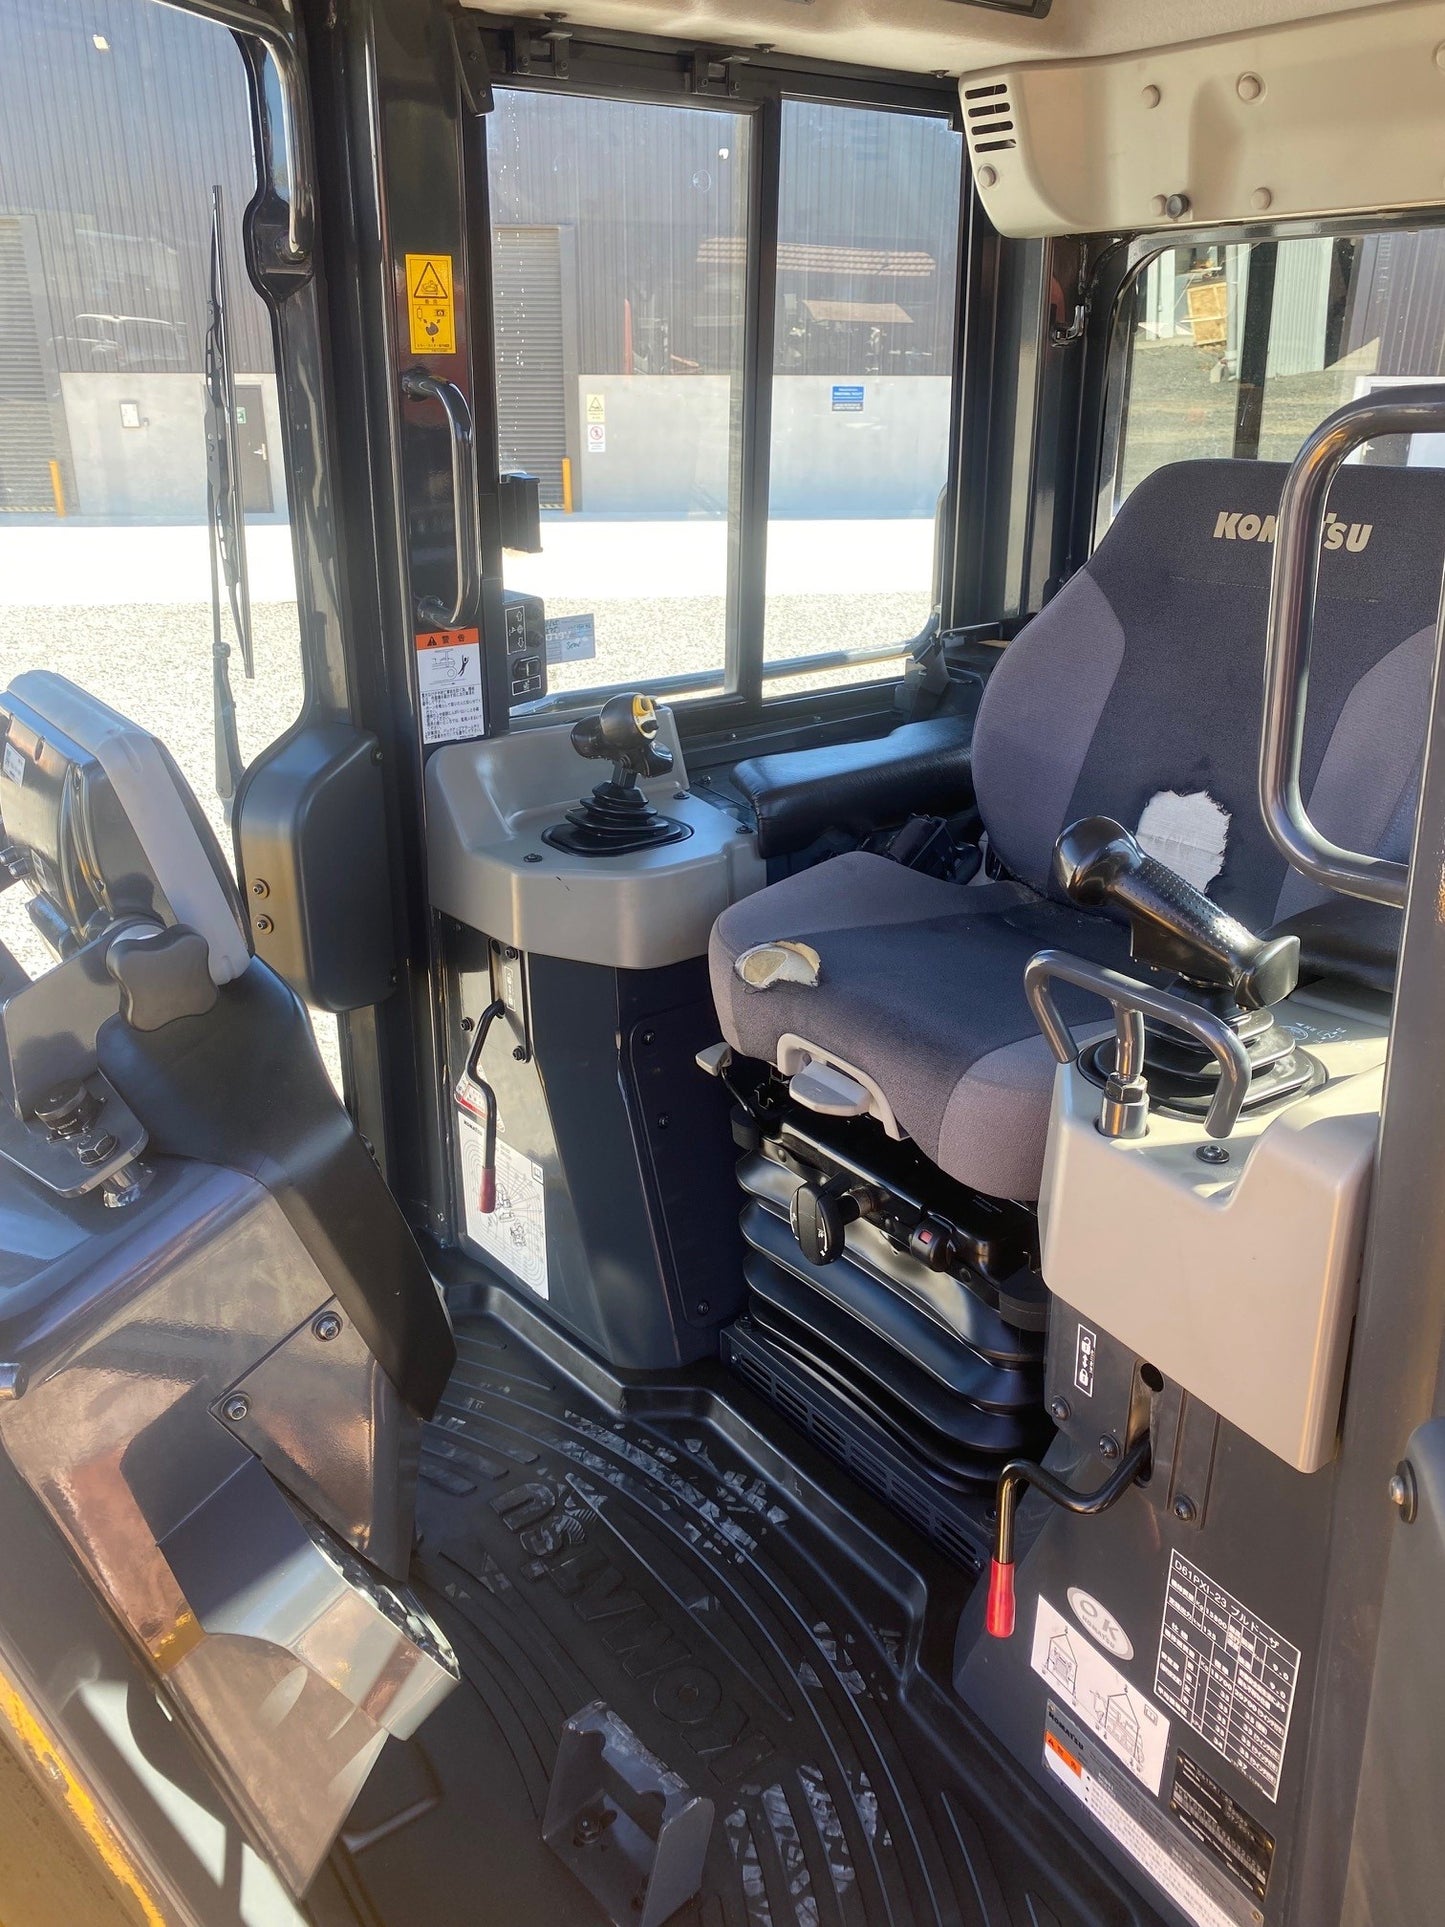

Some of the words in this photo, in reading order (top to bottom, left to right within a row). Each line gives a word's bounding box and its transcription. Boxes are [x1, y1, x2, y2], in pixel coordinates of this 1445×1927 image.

[1213, 511, 1373, 553] KOMSU
[464, 1121, 482, 1136] KOMATSU
[1080, 1600, 1119, 1641] OK
[1082, 1615, 1115, 1650] KOMATSU
[1048, 1711, 1084, 1750] KOMATSU
